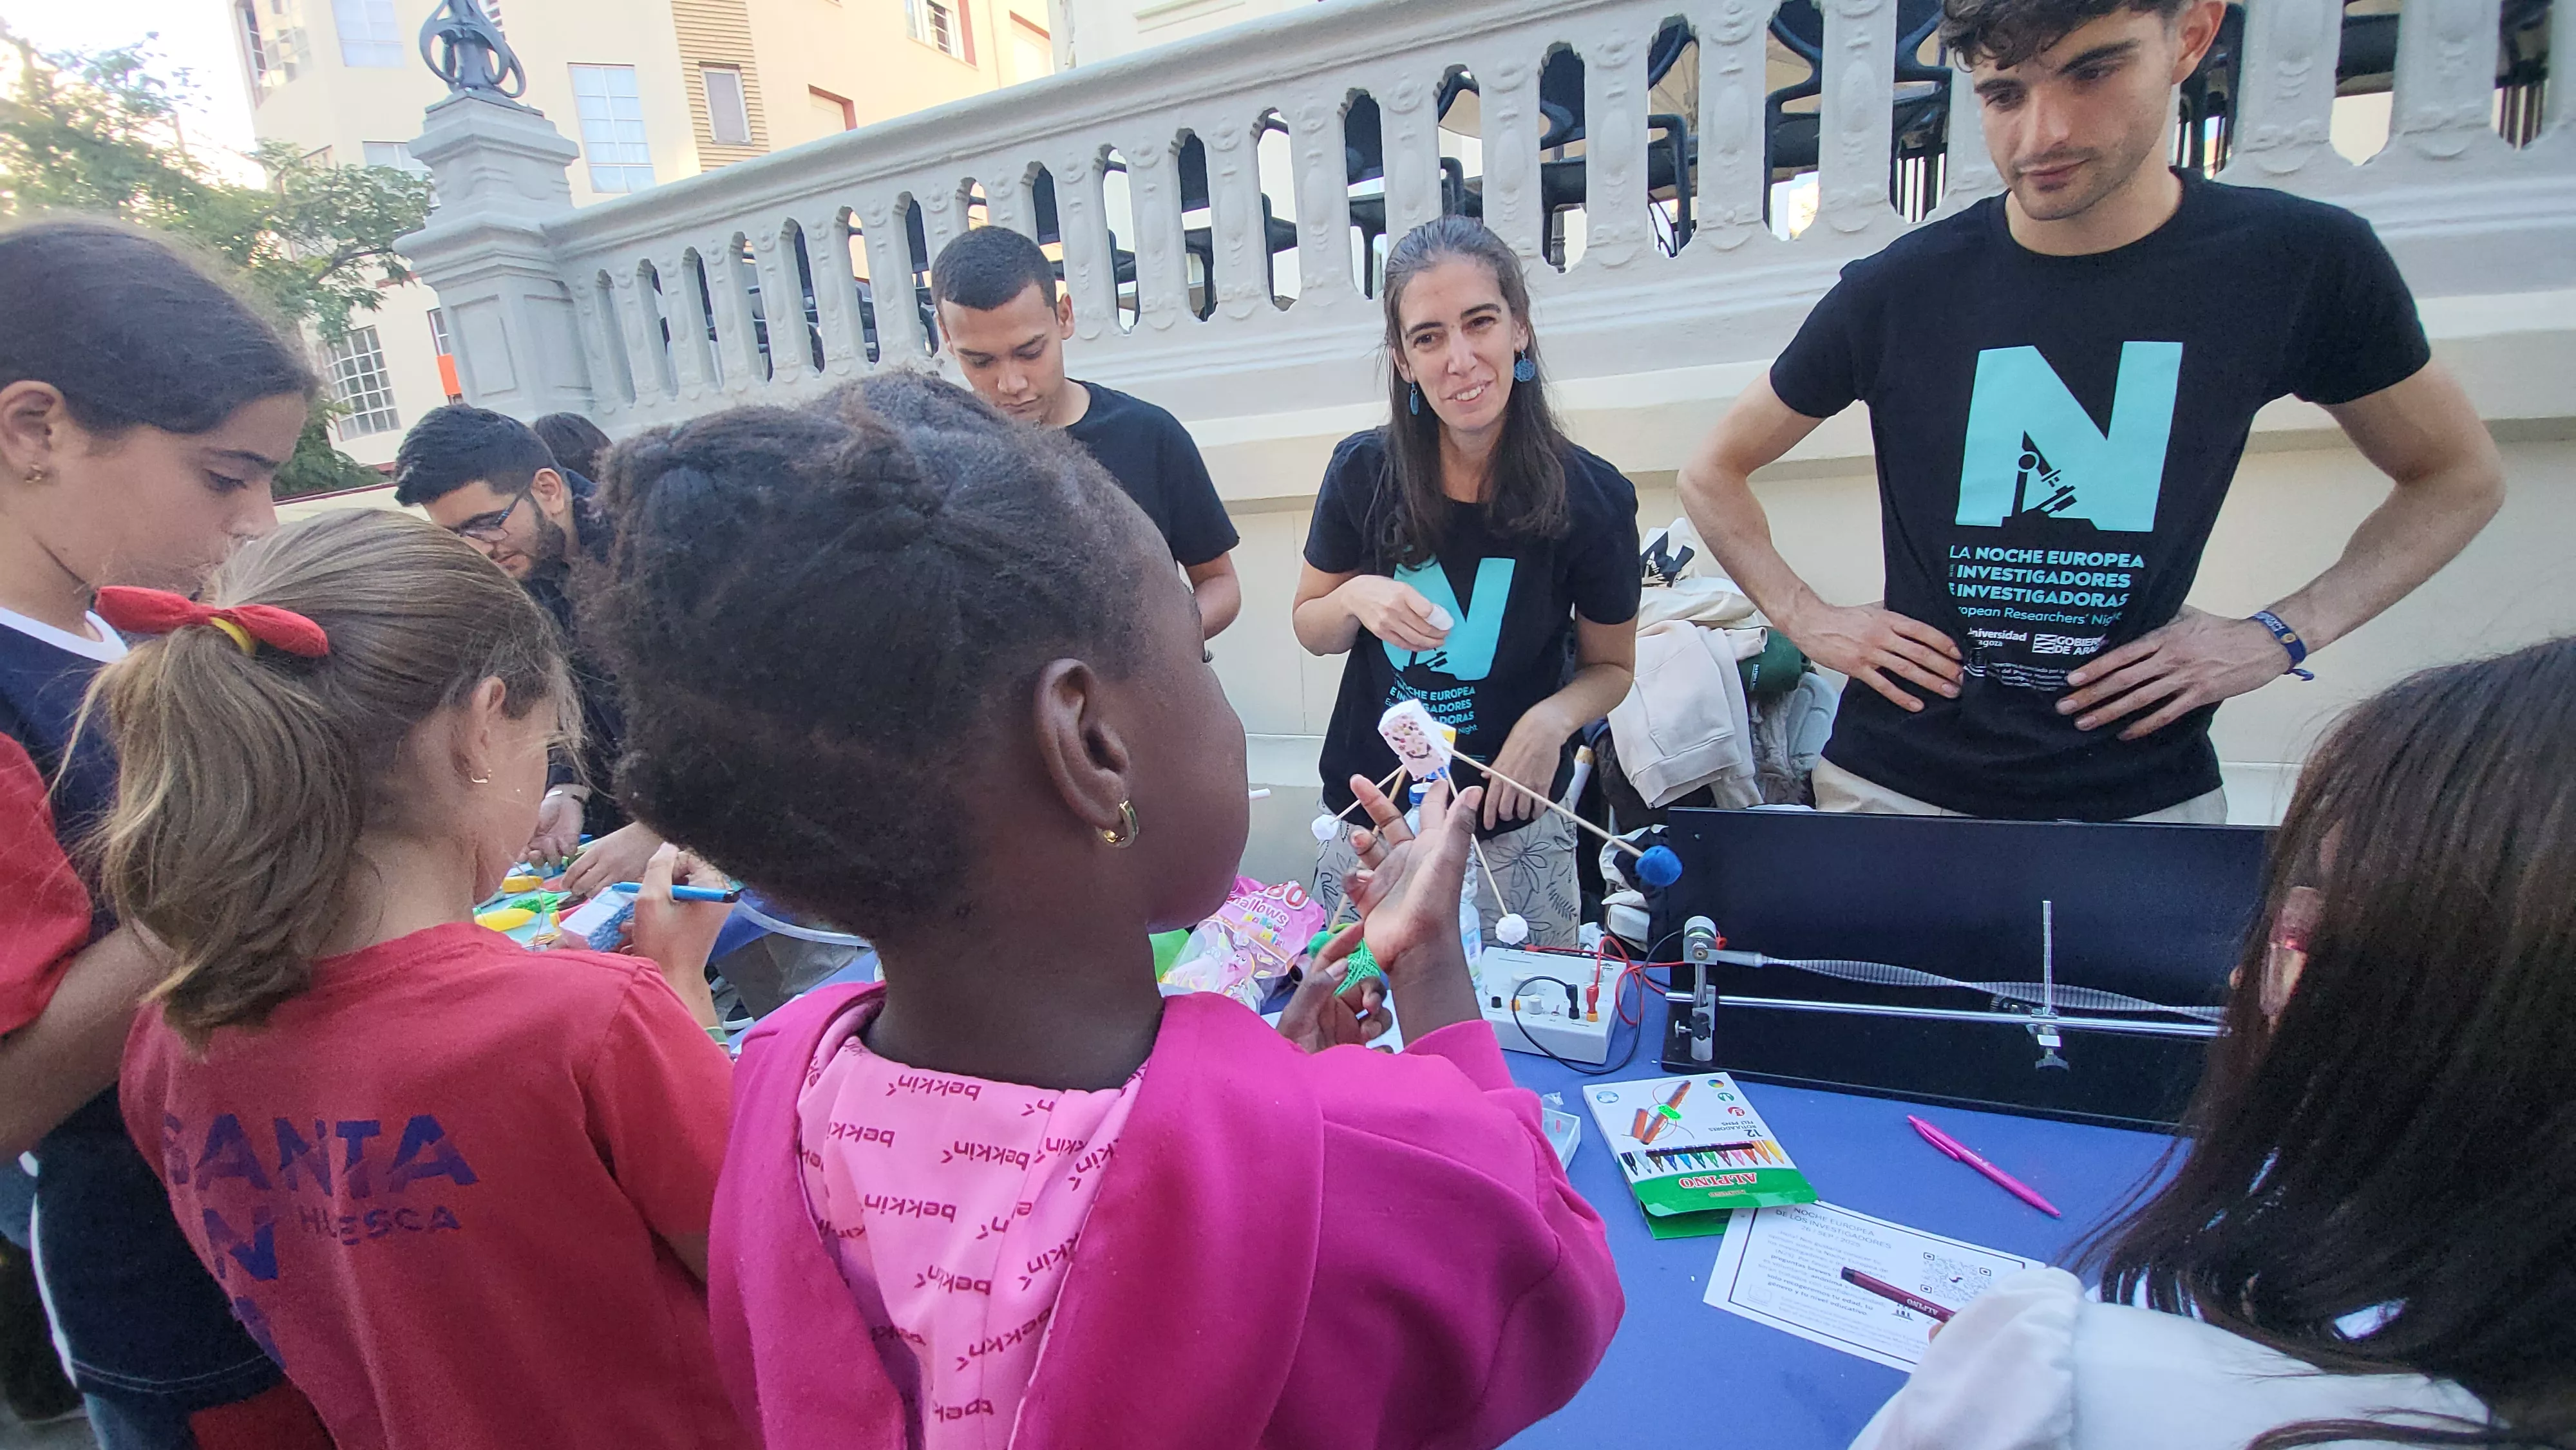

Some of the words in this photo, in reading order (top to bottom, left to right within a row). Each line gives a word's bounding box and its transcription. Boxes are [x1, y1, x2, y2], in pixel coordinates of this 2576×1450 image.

[1949, 545, 1971, 559] LA
[1975, 547, 2043, 564] NOCHE
[2047, 551, 2145, 569] EUROPEA
[1956, 564, 2132, 588] INVESTIGADORES
[1956, 583, 2130, 608] INVESTIGADORAS
[1958, 606, 2001, 617] ropean
[2004, 607, 2088, 625] Researchers'
[1978, 639, 2003, 648] agoza
[2055, 645, 2071, 655] DE
[1430, 686, 1476, 701] EUROPEA
[1423, 699, 1472, 713] GADORES
[897, 1074, 981, 1101] bekkin
[827, 1122, 895, 1147] bekki
[1708, 1124, 1757, 1133] ROTULADORES
[1744, 1129, 1763, 1138] 12
[954, 1140, 1030, 1171] bekkin
[1678, 1172, 1758, 1190] ALPINO
[864, 1193, 956, 1221] bekkin
[1775, 1209, 1787, 1217] DE
[1789, 1213, 1808, 1223] LOS
[1809, 1218, 1892, 1250] INVESTIGADORES
[1793, 1206, 1828, 1222] NOCHE
[1830, 1218, 1875, 1237] EUROPEA
